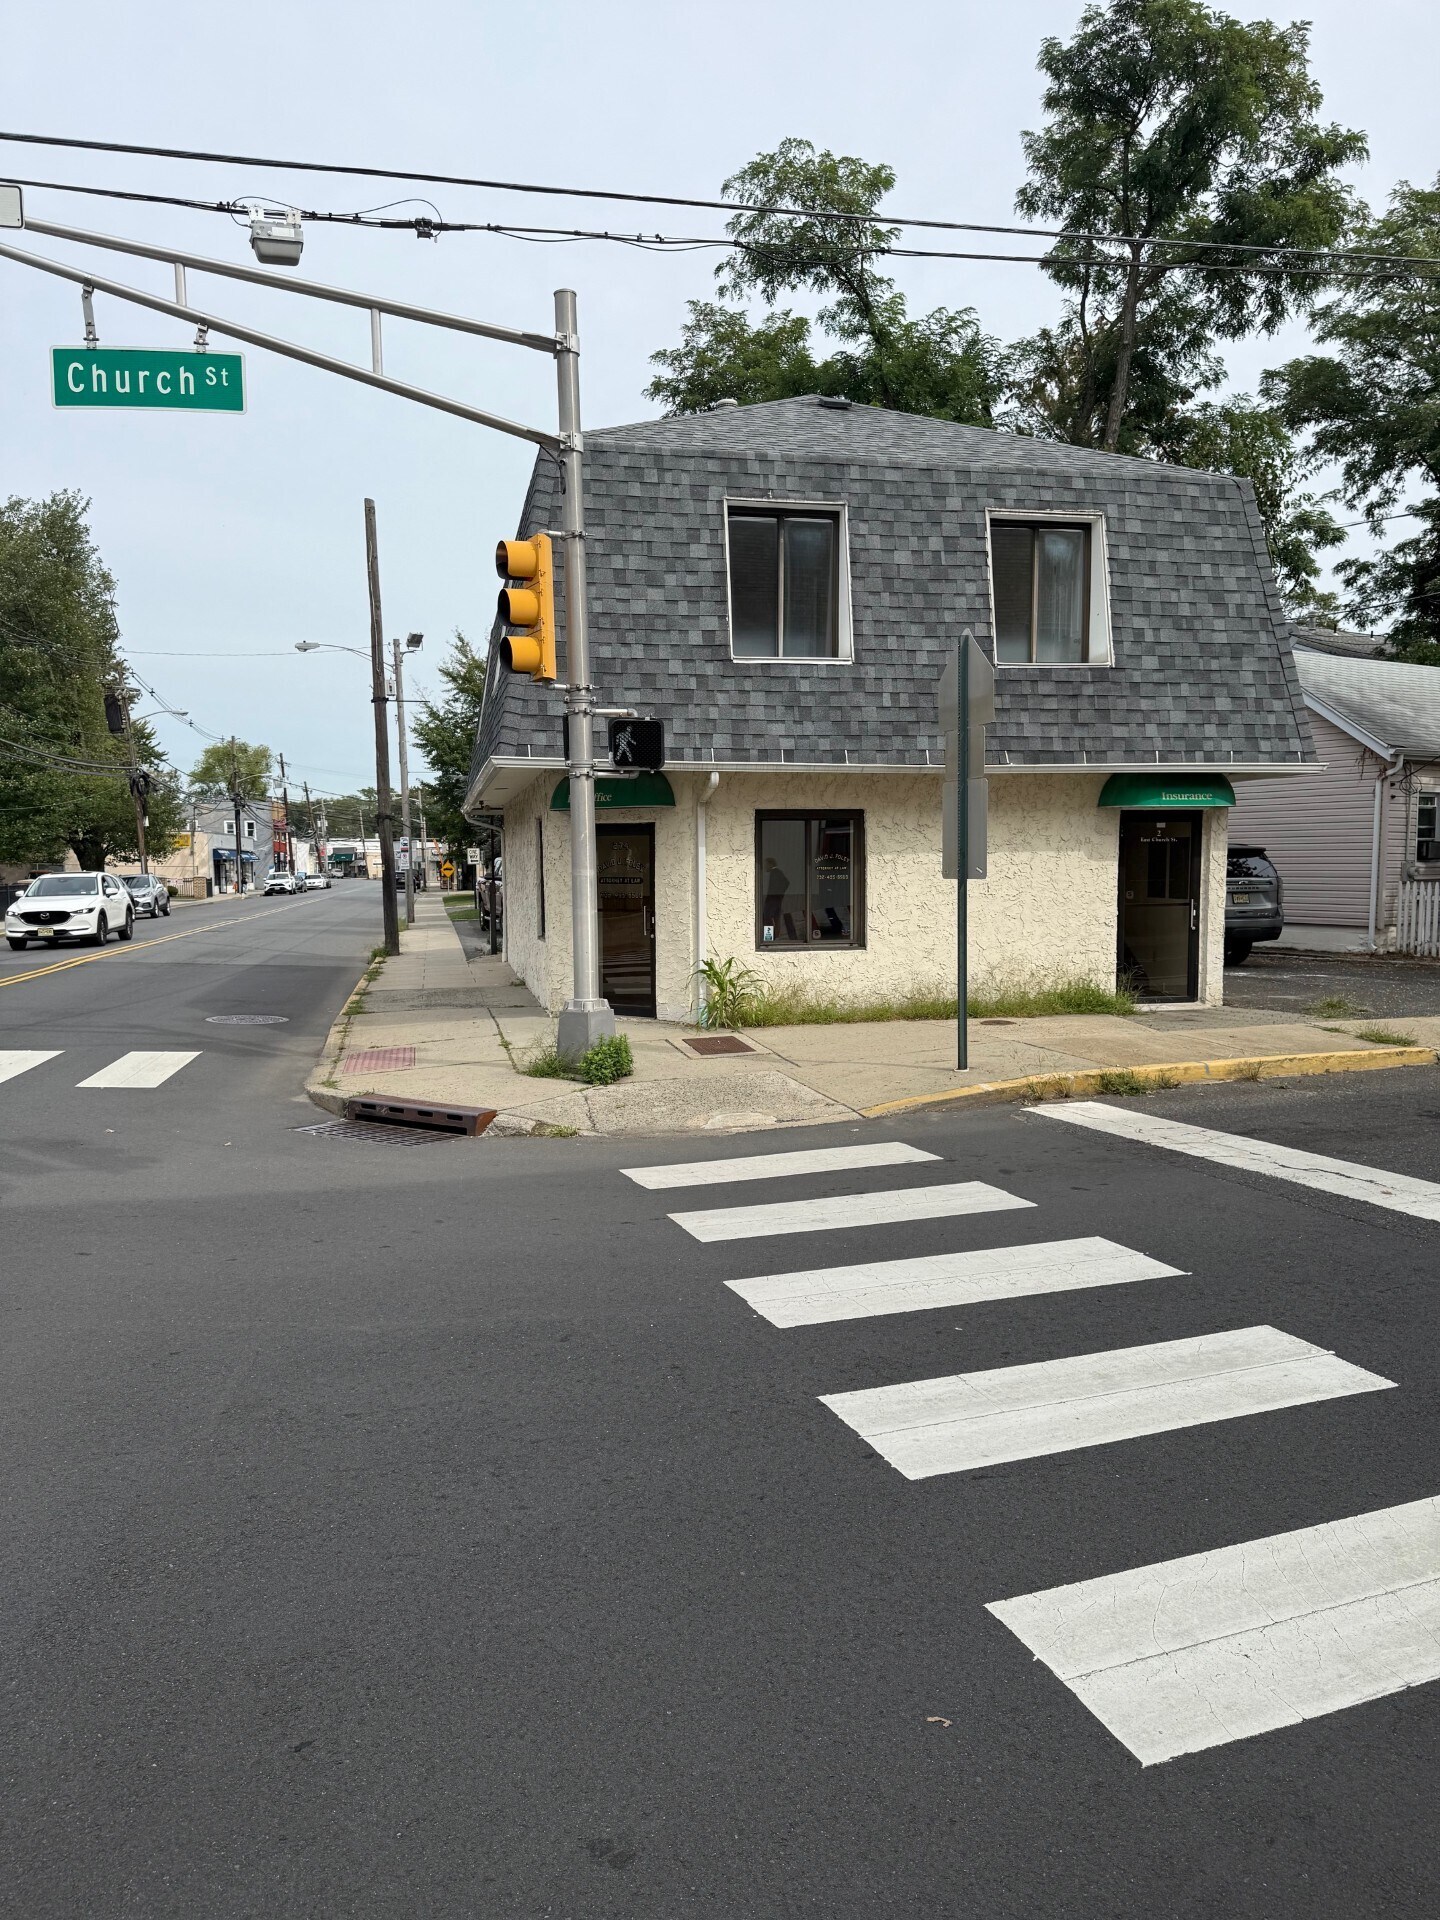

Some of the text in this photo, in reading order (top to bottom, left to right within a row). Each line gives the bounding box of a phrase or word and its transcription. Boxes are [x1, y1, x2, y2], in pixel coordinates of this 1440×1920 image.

[67, 362, 229, 395] Church St
[594, 792, 612, 802] ffice
[1161, 792, 1213, 801] Insurance
[1156, 829, 1162, 837] 2
